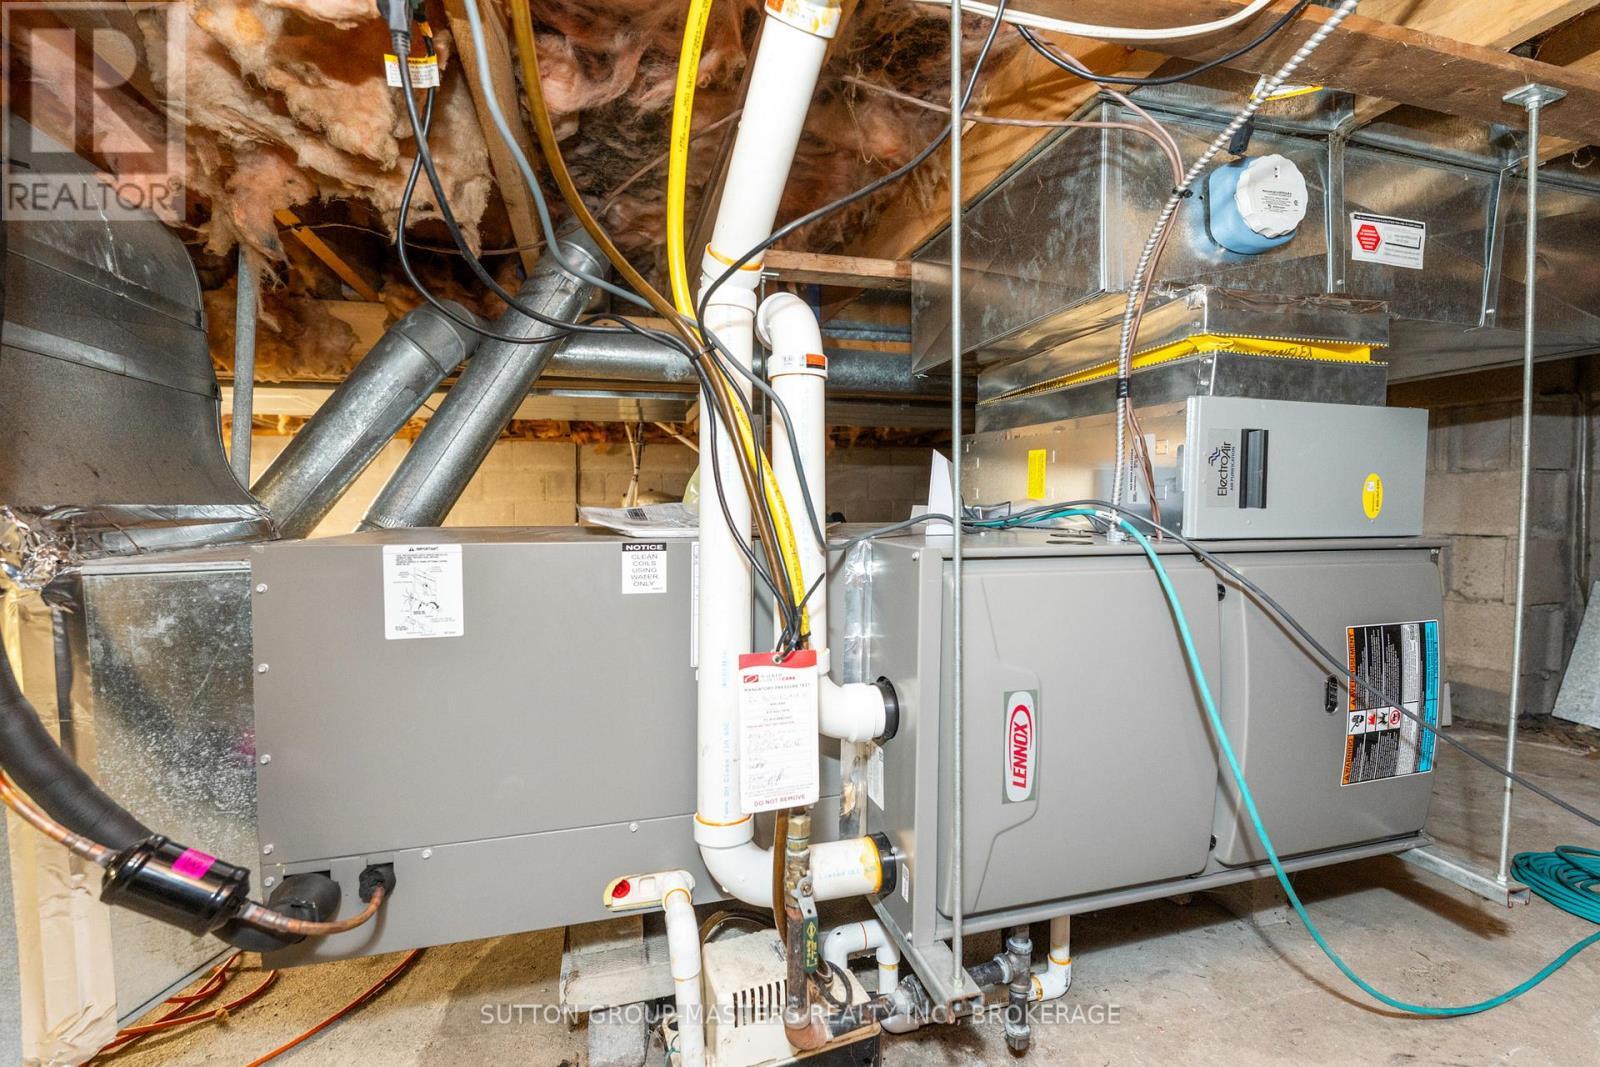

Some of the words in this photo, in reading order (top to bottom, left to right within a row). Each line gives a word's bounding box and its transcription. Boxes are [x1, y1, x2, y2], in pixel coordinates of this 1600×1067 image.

[1217, 441, 1232, 496] ElectroAir
[1012, 721, 1029, 789] LENNOX
[780, 794, 806, 802] REMOVE
